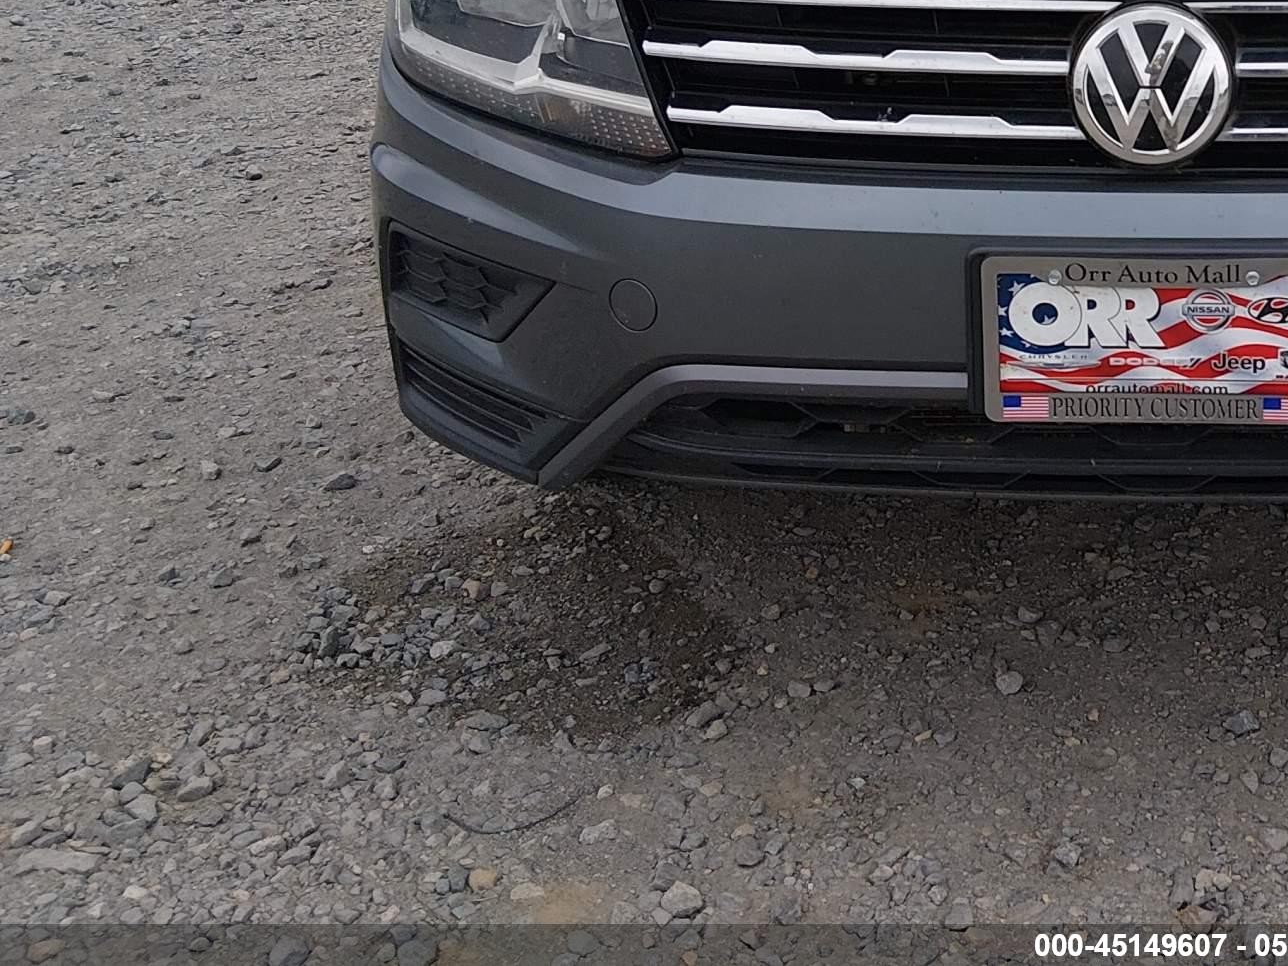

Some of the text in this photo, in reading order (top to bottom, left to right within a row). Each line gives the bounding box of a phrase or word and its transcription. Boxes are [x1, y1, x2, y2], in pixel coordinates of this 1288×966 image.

[1064, 262, 1241, 284] Orr Auto Mall
[1008, 281, 1168, 348] ORR
[1186, 305, 1231, 314] NISSAN
[1212, 352, 1266, 374] Jeep
[1085, 383, 1229, 395] orrautomall.com
[1051, 397, 1259, 420] PRIORITY CUSTOMER
